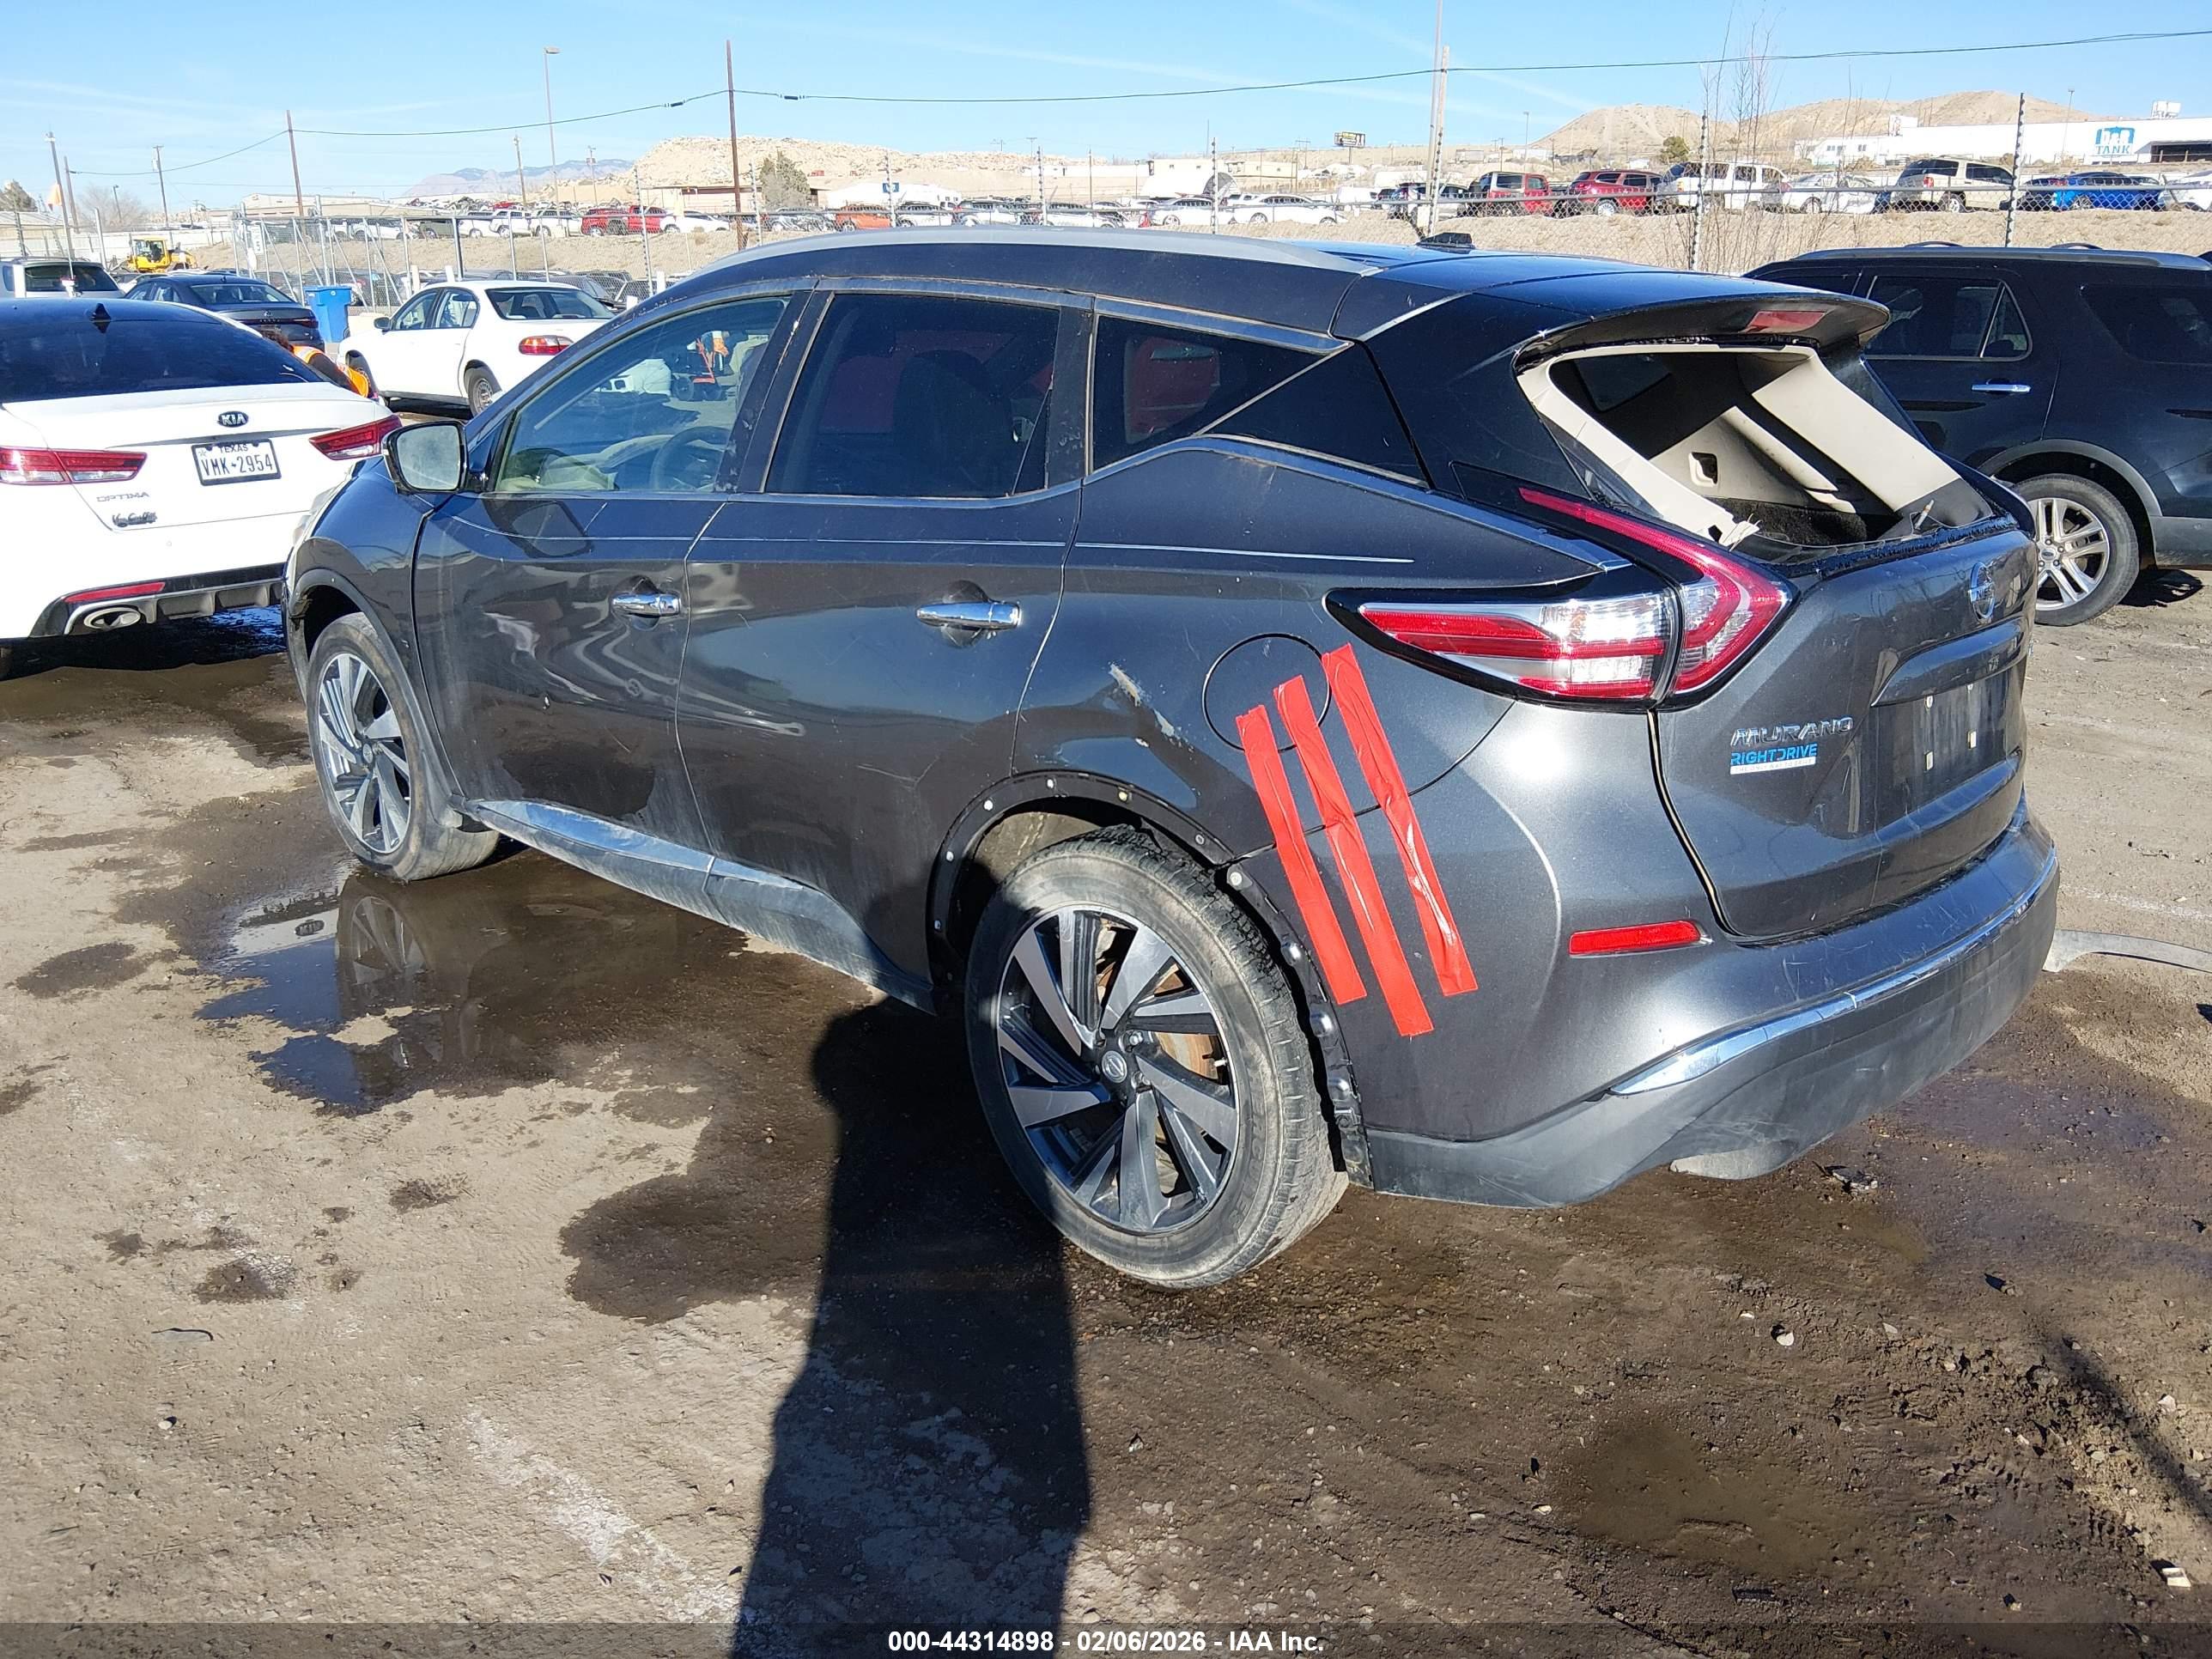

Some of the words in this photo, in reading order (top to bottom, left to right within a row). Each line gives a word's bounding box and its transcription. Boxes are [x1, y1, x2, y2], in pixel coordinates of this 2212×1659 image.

[2095, 145, 2130, 155] TANK
[221, 413, 246, 426] KIA
[220, 444, 249, 454] TEXAS
[96, 491, 149, 502] OPTIMA
[1730, 716, 1854, 746] MURANO
